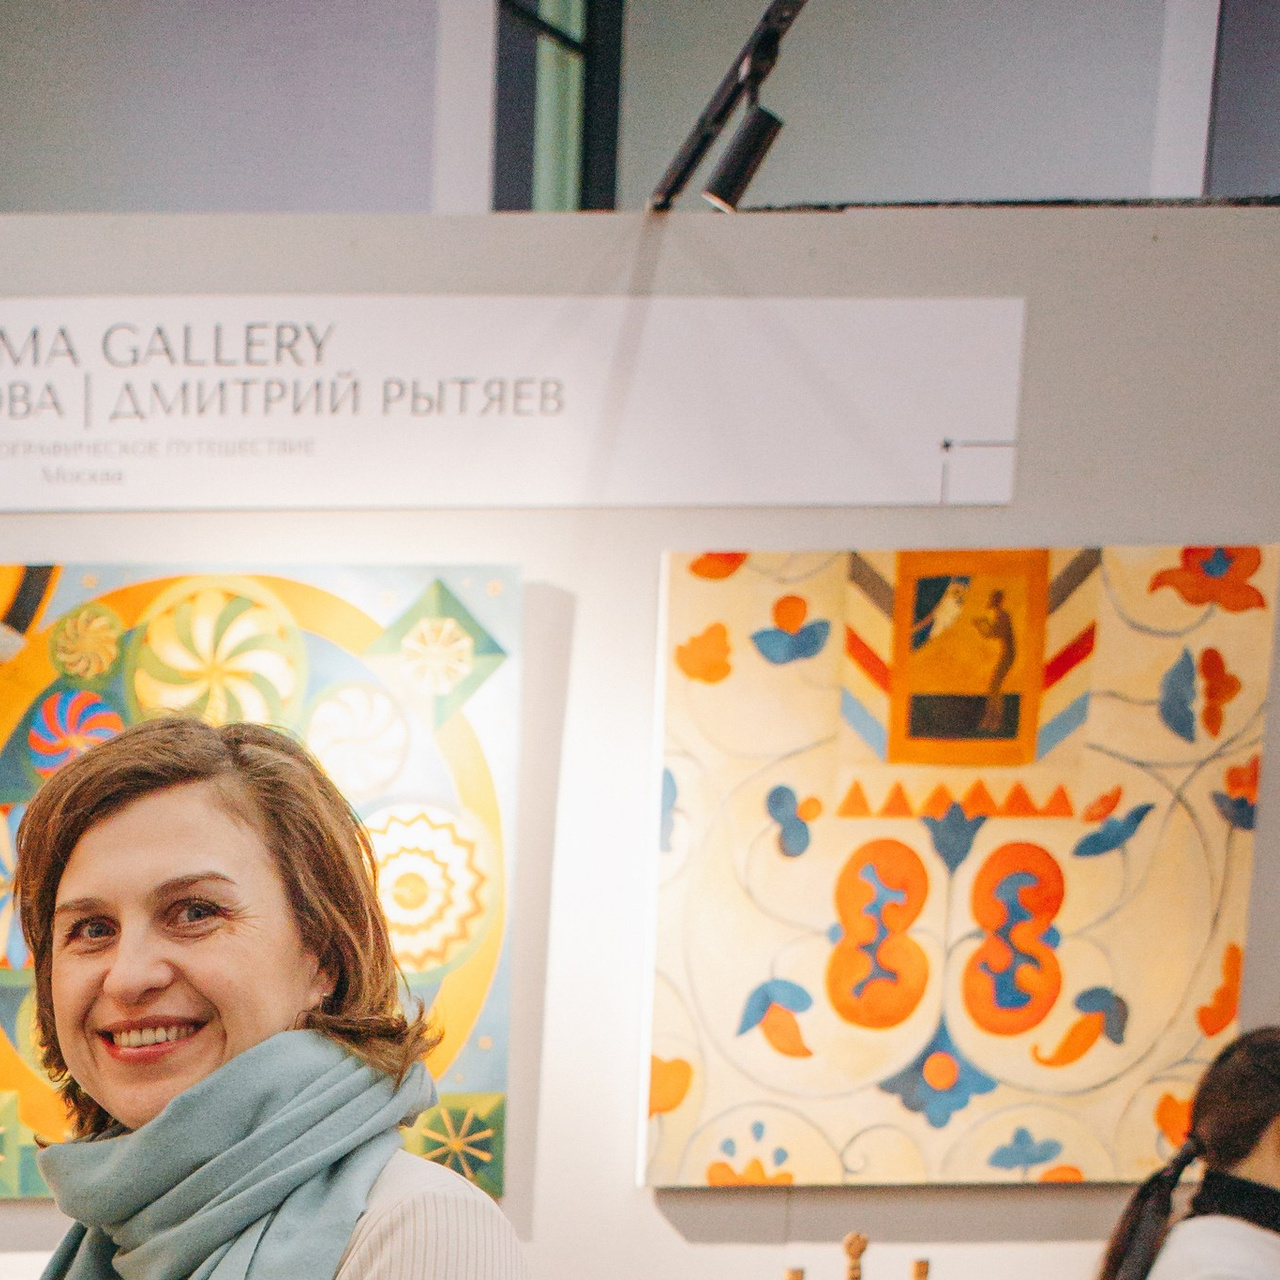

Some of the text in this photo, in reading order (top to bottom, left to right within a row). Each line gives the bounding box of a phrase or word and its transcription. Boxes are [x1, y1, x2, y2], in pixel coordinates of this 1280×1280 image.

[100, 322, 335, 370] GALLERY
[108, 370, 361, 422] ДМИТРИЙ
[380, 376, 565, 417] РЫТЯЕВ
